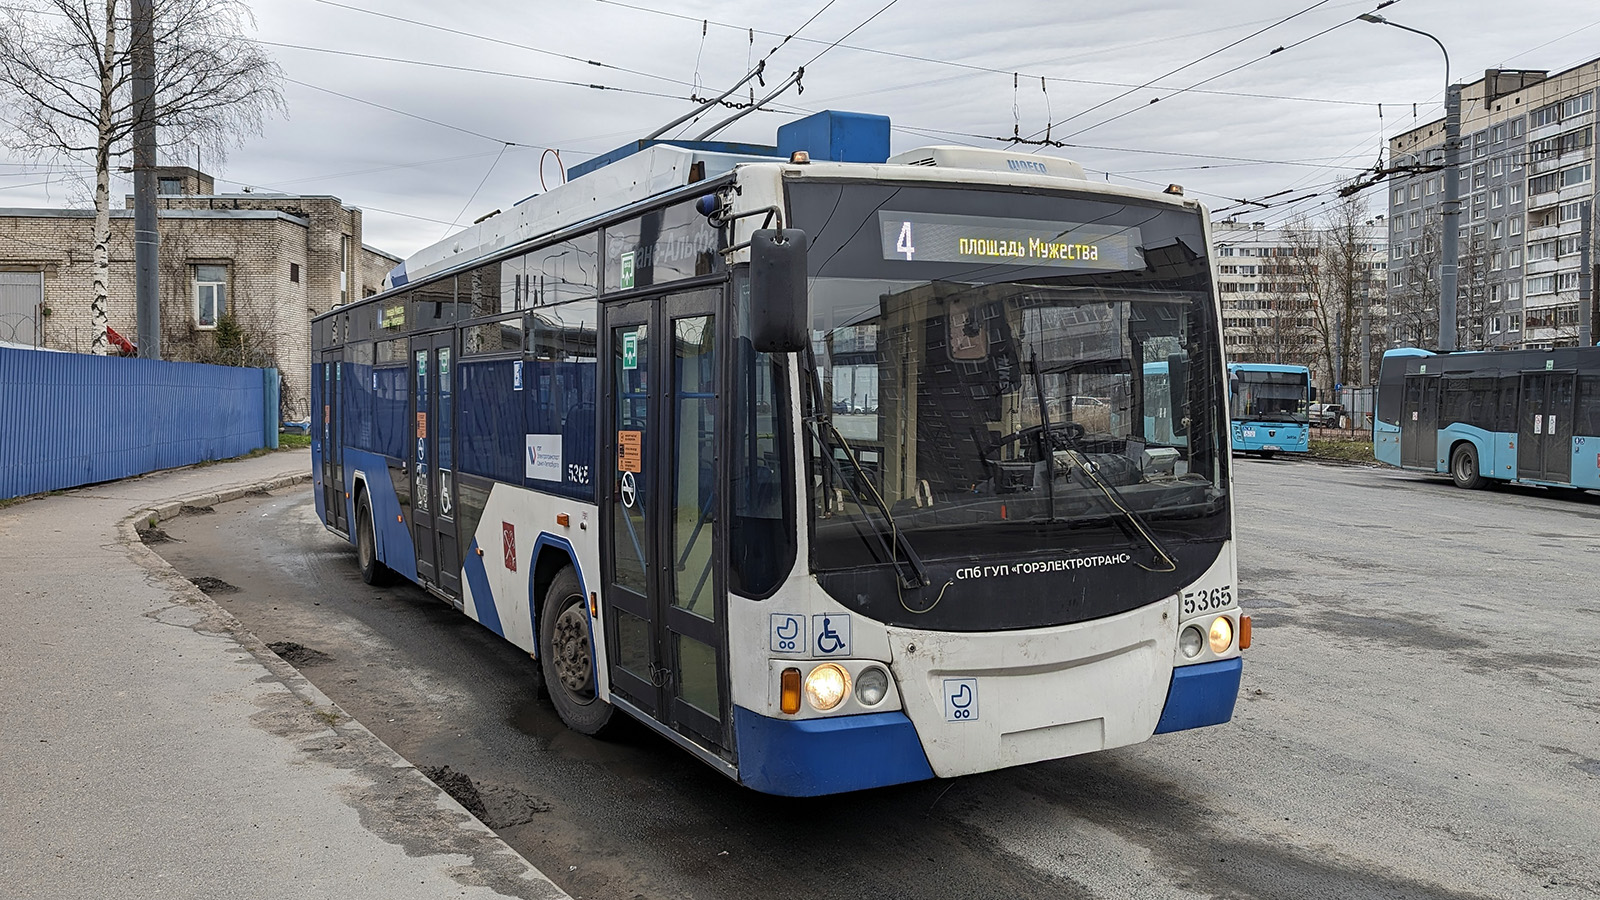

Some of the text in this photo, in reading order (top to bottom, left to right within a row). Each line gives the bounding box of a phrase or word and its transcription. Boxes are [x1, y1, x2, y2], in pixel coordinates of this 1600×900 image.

[897, 221, 1098, 261] 4 площадь Мужества
[568, 464, 589, 484] 5365
[955, 553, 1131, 580] СПб ГУП «ГОРЭЛЕКТРОТРАНС»
[1184, 585, 1232, 614] 5365
